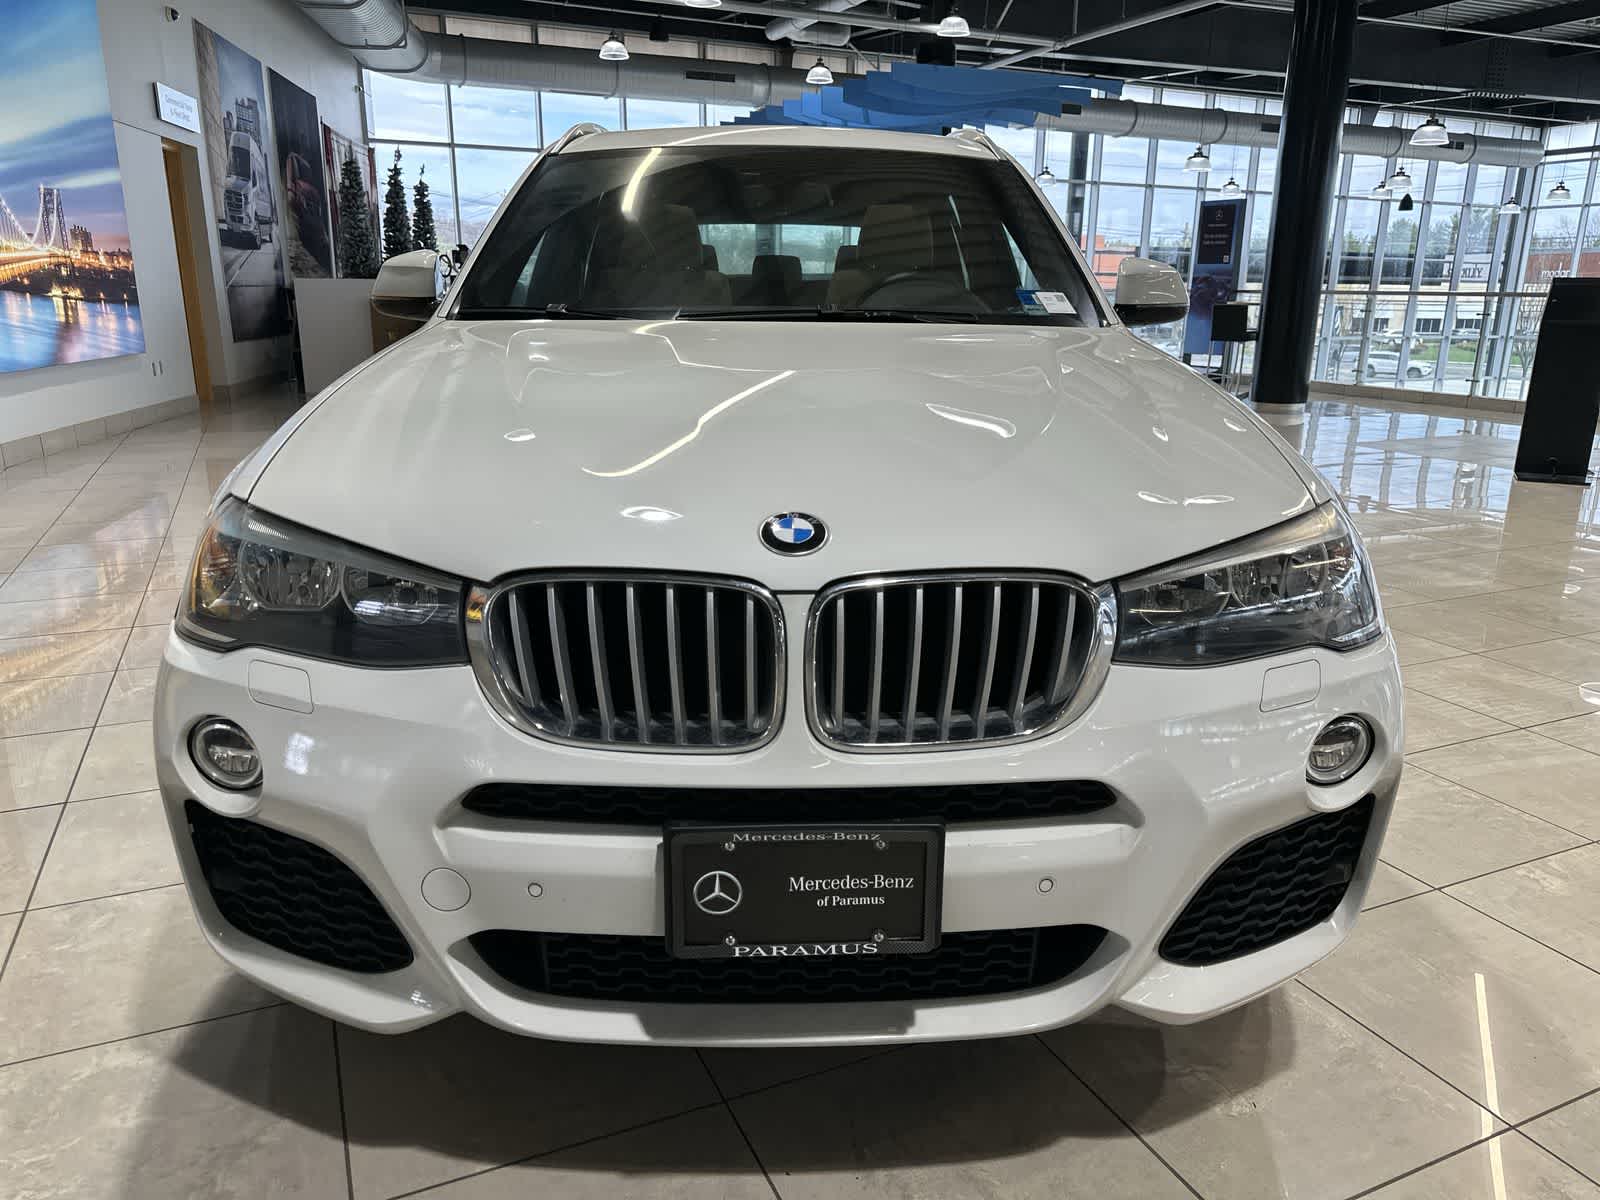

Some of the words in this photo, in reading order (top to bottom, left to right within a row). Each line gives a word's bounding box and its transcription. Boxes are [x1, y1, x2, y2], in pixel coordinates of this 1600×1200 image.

[732, 832, 882, 842] Mercedes-Benz
[788, 874, 915, 892] Mercedes-Benz
[816, 895, 829, 907] of
[831, 895, 886, 907] Paramus
[732, 943, 879, 958] PARAMUS
